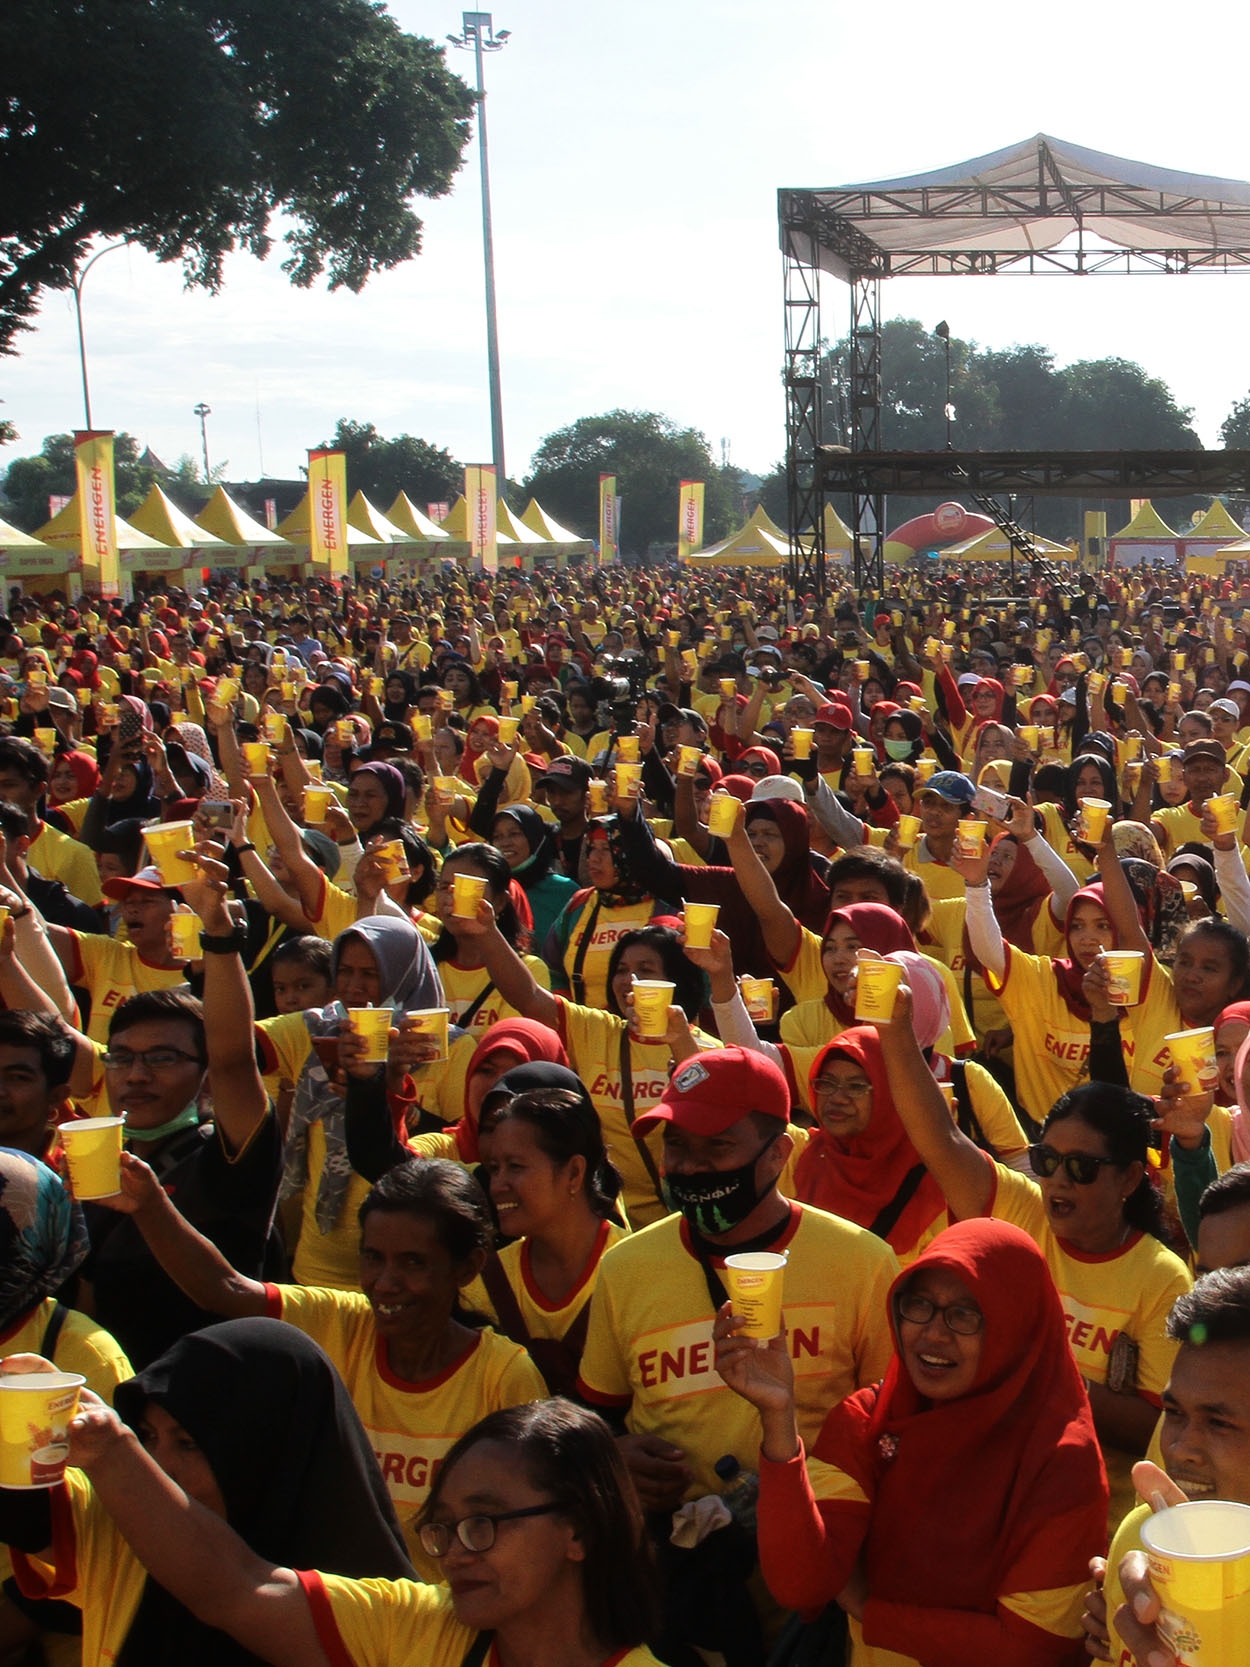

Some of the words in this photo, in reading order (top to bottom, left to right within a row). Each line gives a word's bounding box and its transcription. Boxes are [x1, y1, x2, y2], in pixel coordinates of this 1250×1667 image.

[89, 466, 109, 556] ENERGEN
[324, 479, 337, 550] ENERGEN
[687, 498, 695, 544] ENERGEN
